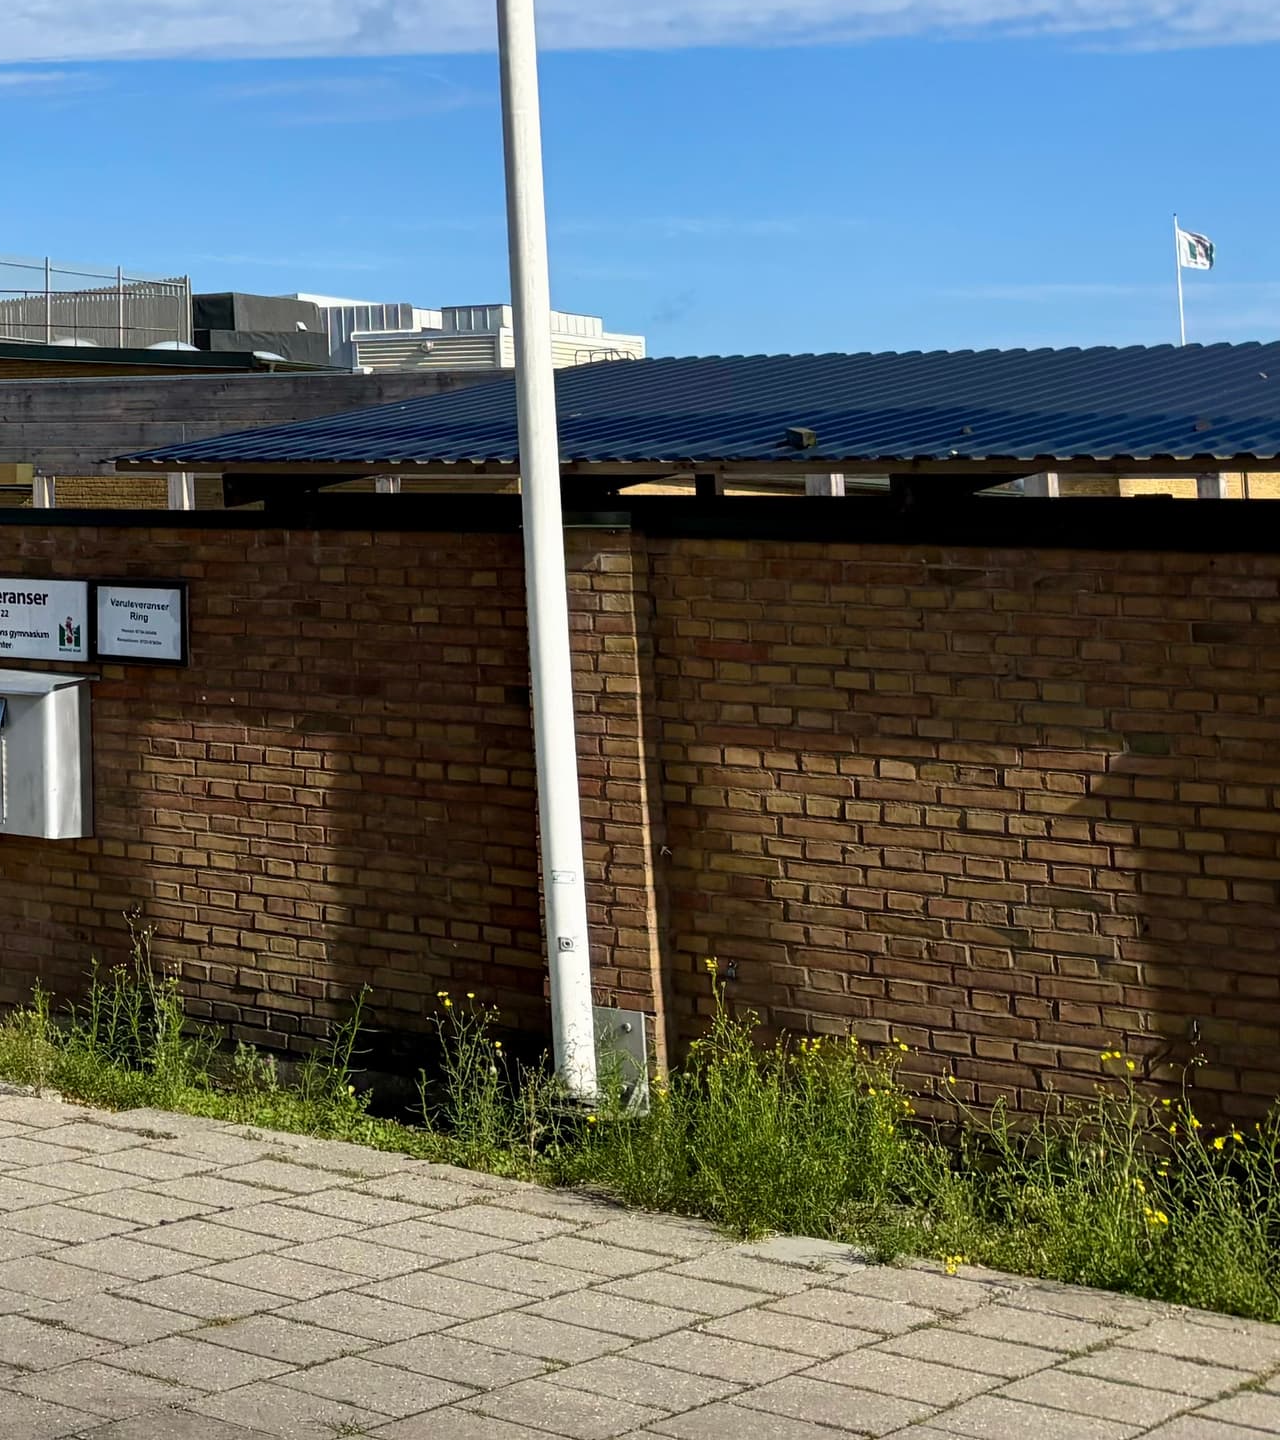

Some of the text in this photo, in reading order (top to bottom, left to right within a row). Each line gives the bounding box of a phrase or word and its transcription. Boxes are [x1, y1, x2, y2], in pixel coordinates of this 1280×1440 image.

[110, 598, 170, 611] Varuleveranser
[0, 609, 9, 618] 22
[129, 611, 149, 624] Ring
[9, 629, 50, 639] gymnasium
